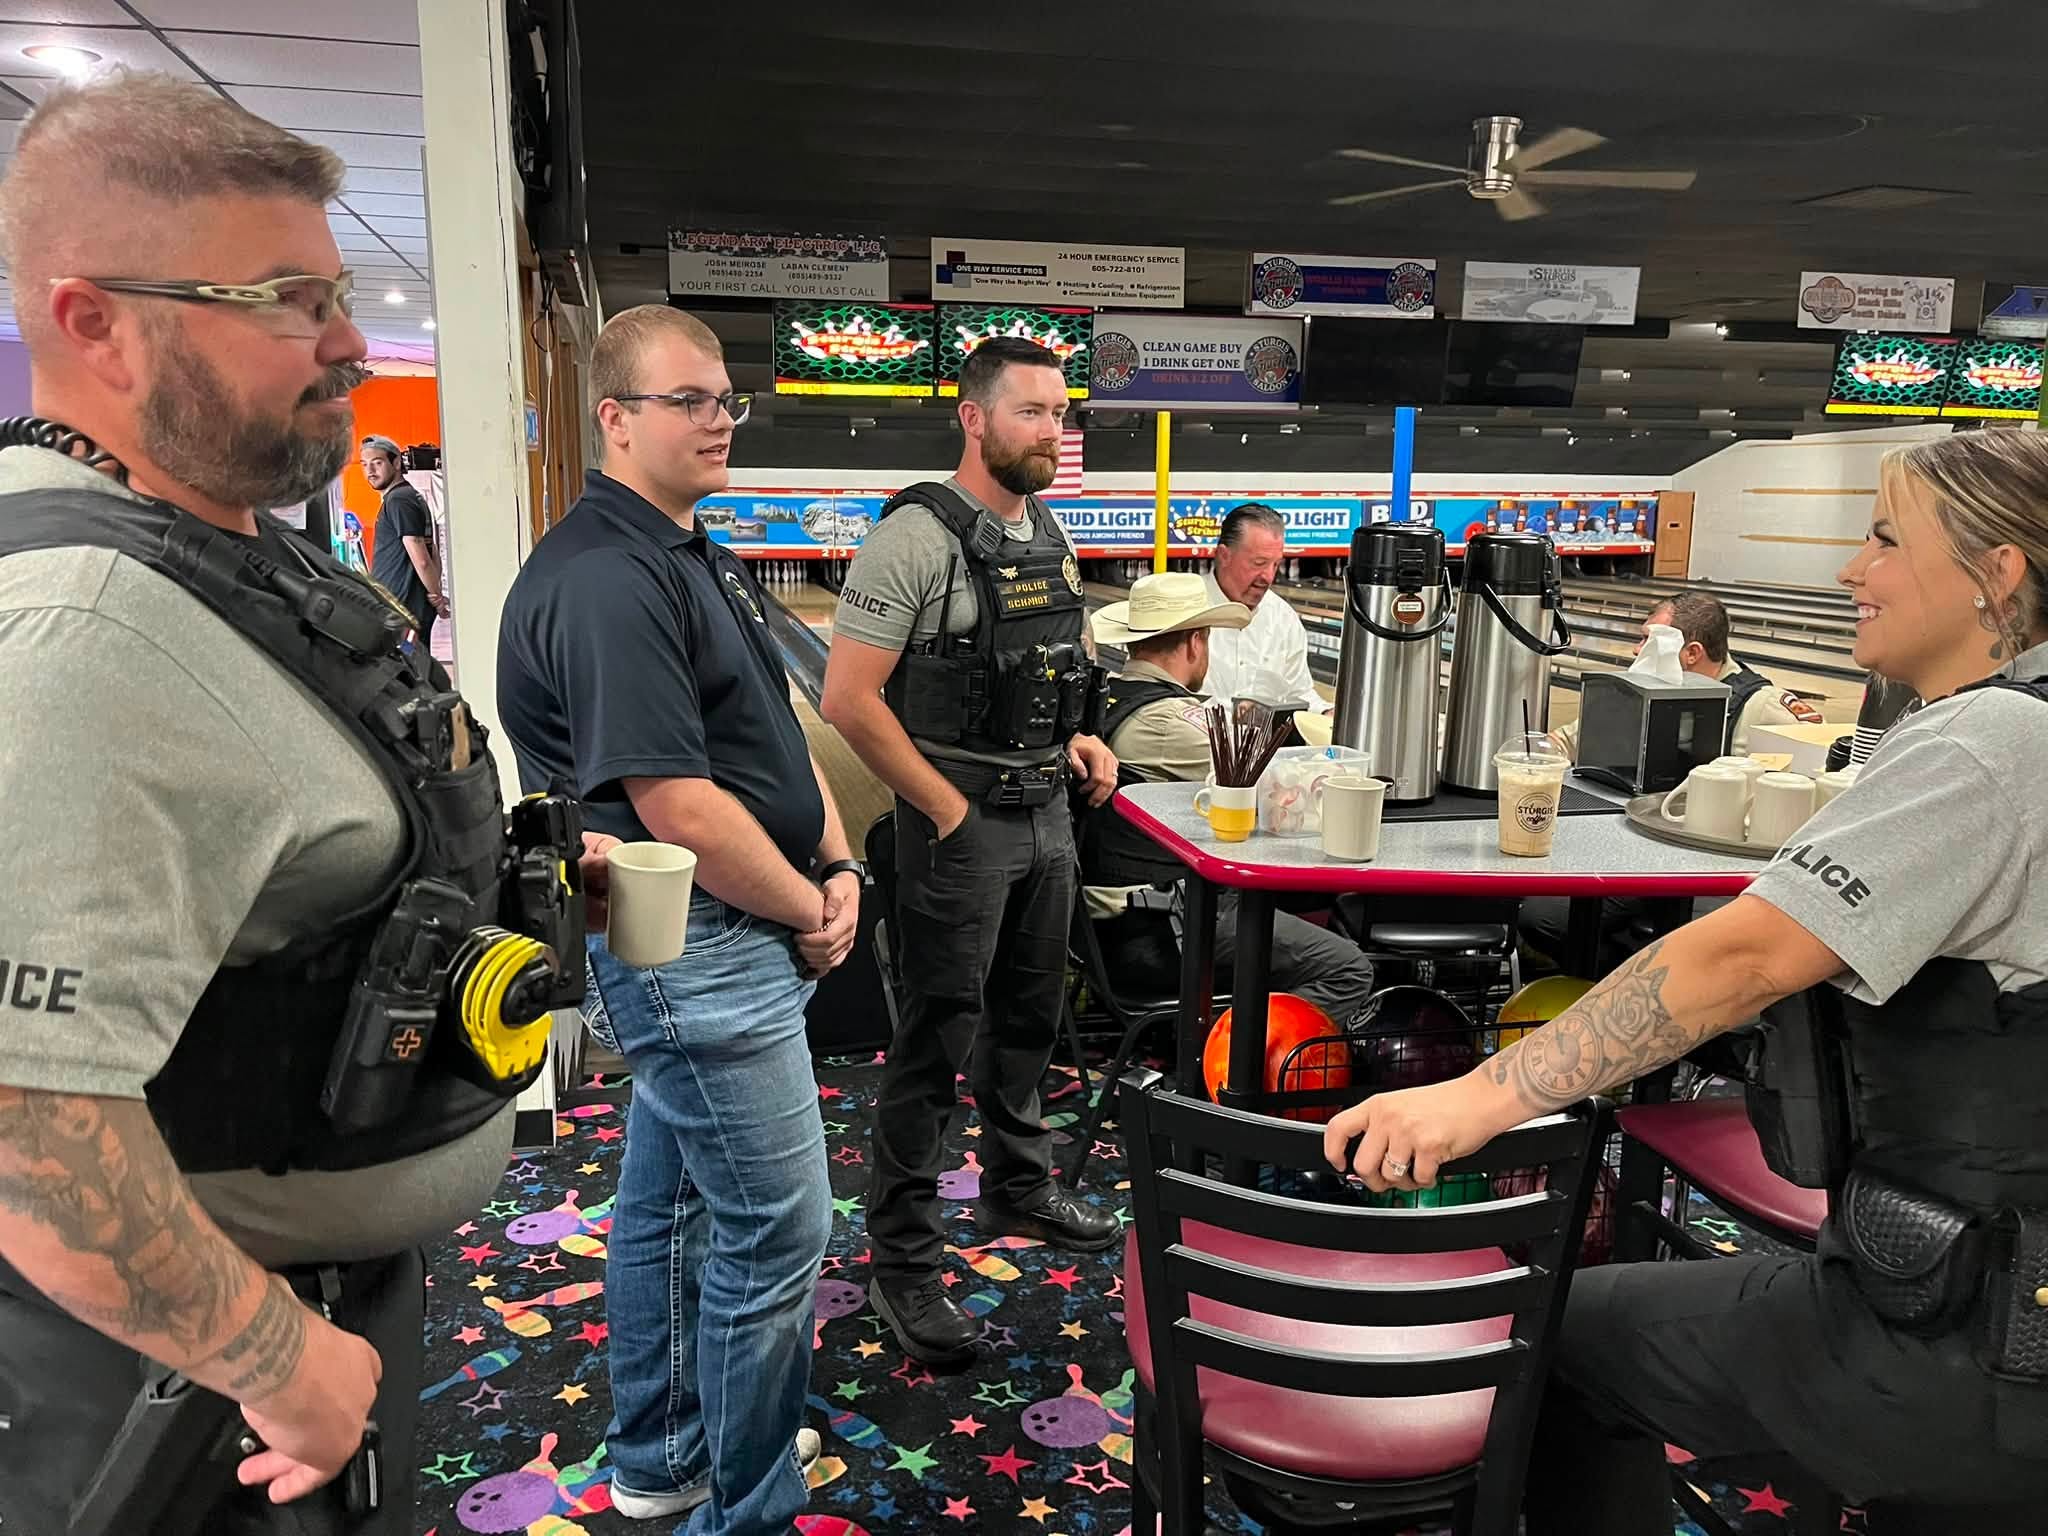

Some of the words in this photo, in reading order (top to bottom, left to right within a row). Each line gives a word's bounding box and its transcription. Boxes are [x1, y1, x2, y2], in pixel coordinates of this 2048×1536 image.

[678, 233, 769, 248] LEGENDARY
[774, 237, 849, 250] ELECTRIC
[853, 241, 881, 252] LLC
[704, 259, 727, 267] JOSH
[1058, 252, 1068, 260] 24
[1069, 253, 1092, 261] HOUR
[1094, 254, 1145, 263] EMERGENCY
[1147, 256, 1180, 264] SERVICE
[811, 263, 849, 272] CLEMENT
[956, 264, 972, 273] ONE
[973, 265, 990, 273] WAY
[992, 266, 1022, 275] SERVICE
[1023, 267, 1044, 275] PROS
[679, 281, 711, 291] YOUR
[714, 281, 746, 292] FIRST
[785, 284, 816, 295] YOUR
[819, 285, 846, 296] LAST
[1093, 332, 1132, 350] STURGIS
[1142, 342, 1180, 352] CLEAN
[1183, 342, 1217, 353] GAME
[1220, 343, 1243, 354] BUY
[1252, 337, 1290, 353] STURGIS
[1143, 359, 1149, 367] 1
[1151, 359, 1189, 368] DRINK
[1192, 359, 1214, 368] GET
[1217, 359, 1240, 369] ONE
[1094, 375, 1130, 390] SALOON
[1058, 511, 1095, 526] BUD
[1098, 511, 1152, 527] LIGHT
[1295, 512, 1347, 526] LIGHT
[1371, 501, 1428, 524] BD
[822, 549, 829, 557] 2
[840, 549, 847, 557] 3
[1015, 580, 1048, 593] POLICE
[842, 586, 890, 617] POLICE
[1007, 595, 1049, 609] SCHMIDT
[1517, 803, 1553, 816] STURGIS
[1776, 844, 1871, 908] LICE
[0, 959, 83, 1014] ICE
